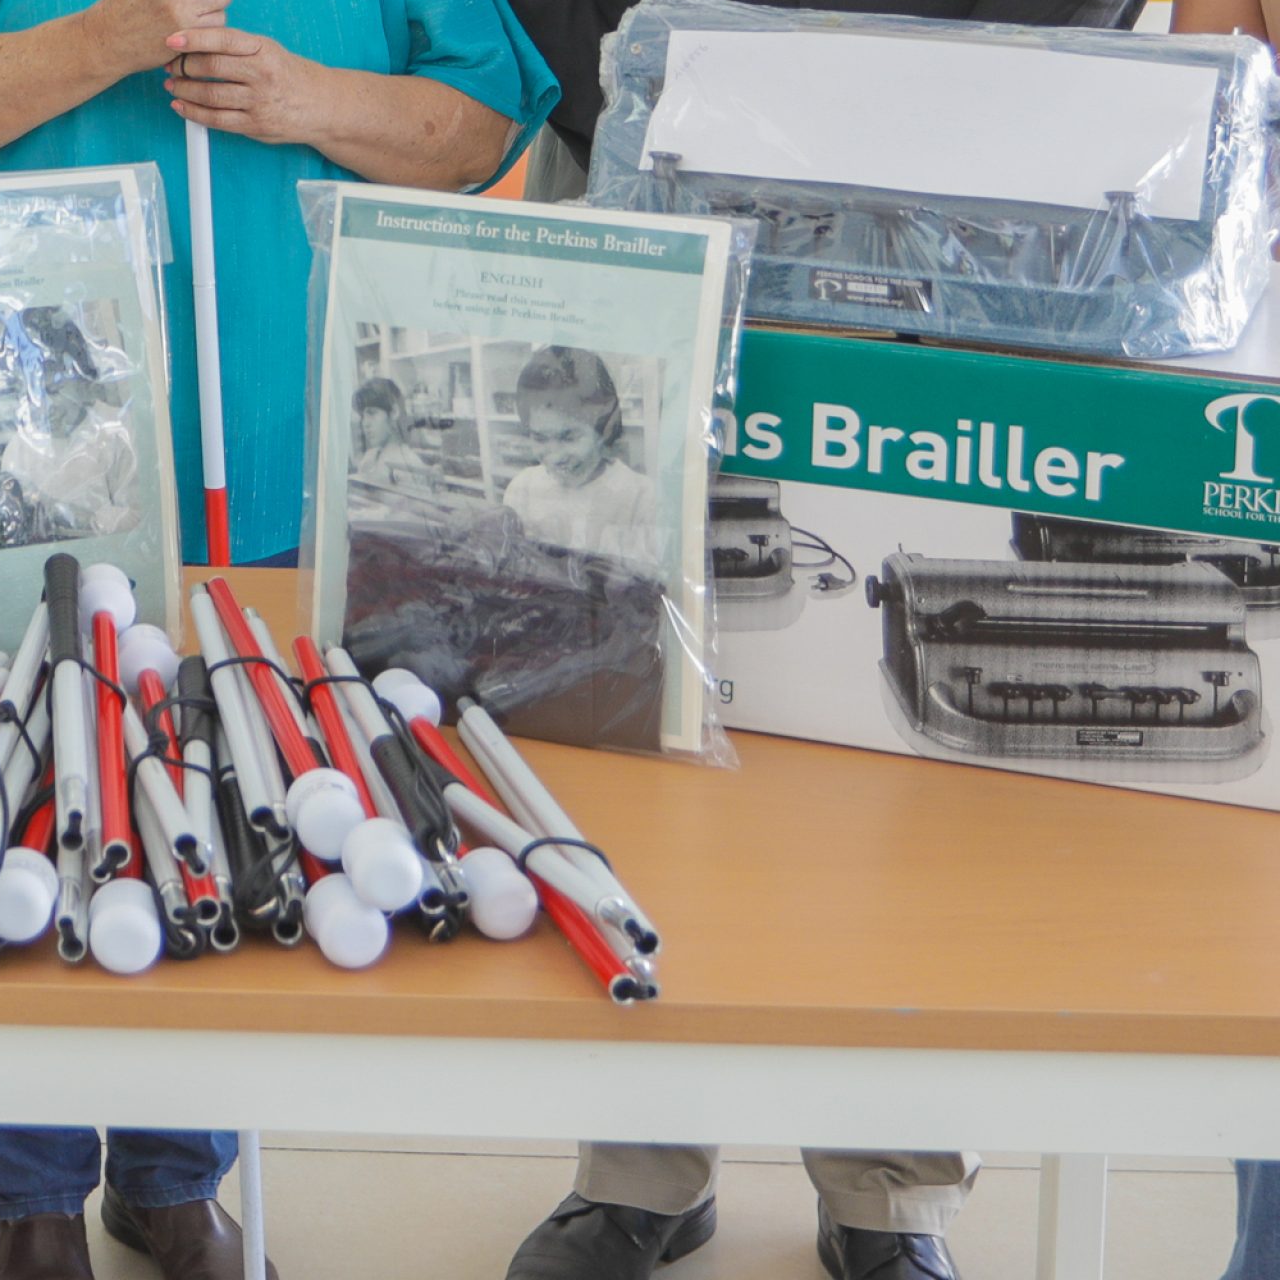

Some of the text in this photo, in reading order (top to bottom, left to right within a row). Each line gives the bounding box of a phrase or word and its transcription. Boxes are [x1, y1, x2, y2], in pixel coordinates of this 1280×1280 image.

[376, 210, 667, 257] Instructions for the Perkins Brailler
[480, 271, 543, 289] ENGLISH
[511, 308, 547, 321] Perkins
[811, 402, 1125, 501] Brailler
[1203, 506, 1243, 519] SCHOOL
[1246, 512, 1265, 522] FOR
